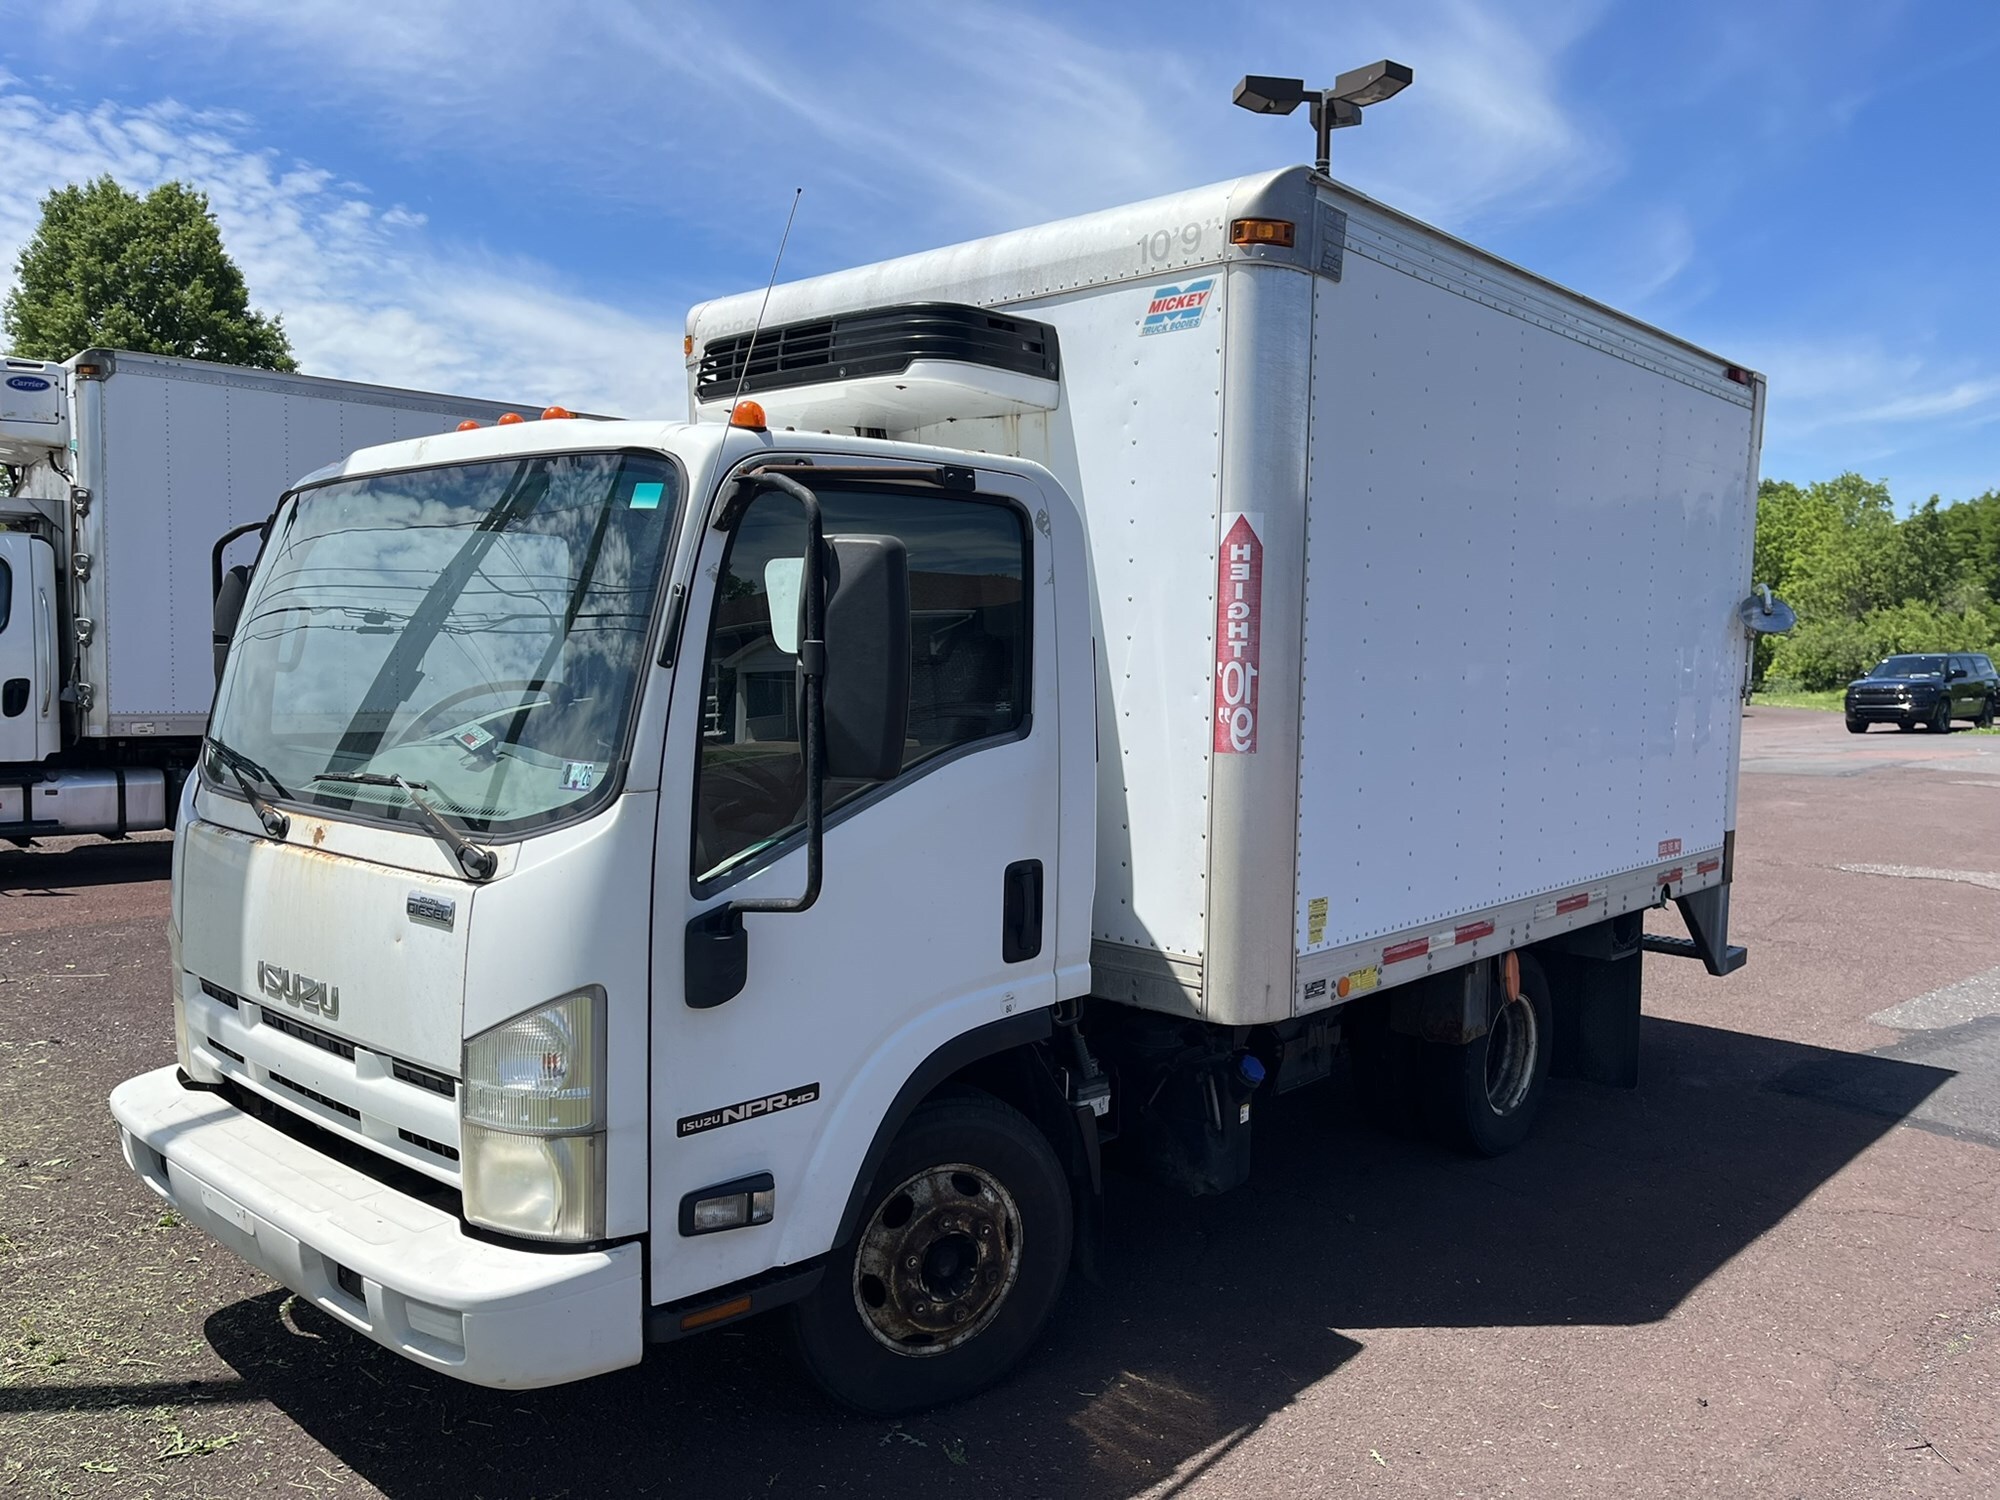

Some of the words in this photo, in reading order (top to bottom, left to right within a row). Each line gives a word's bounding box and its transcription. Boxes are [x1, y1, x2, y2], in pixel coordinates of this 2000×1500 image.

[1148, 291, 1209, 314] MICKEY
[1142, 323, 1169, 335] TRUCK
[1169, 317, 1200, 331] BODIES
[11, 379, 45, 388] Carrier
[407, 902, 449, 922] DIESEL
[257, 960, 340, 1020] ISUZU
[682, 1114, 721, 1132] ISUZU
[722, 1093, 788, 1124] NPR
